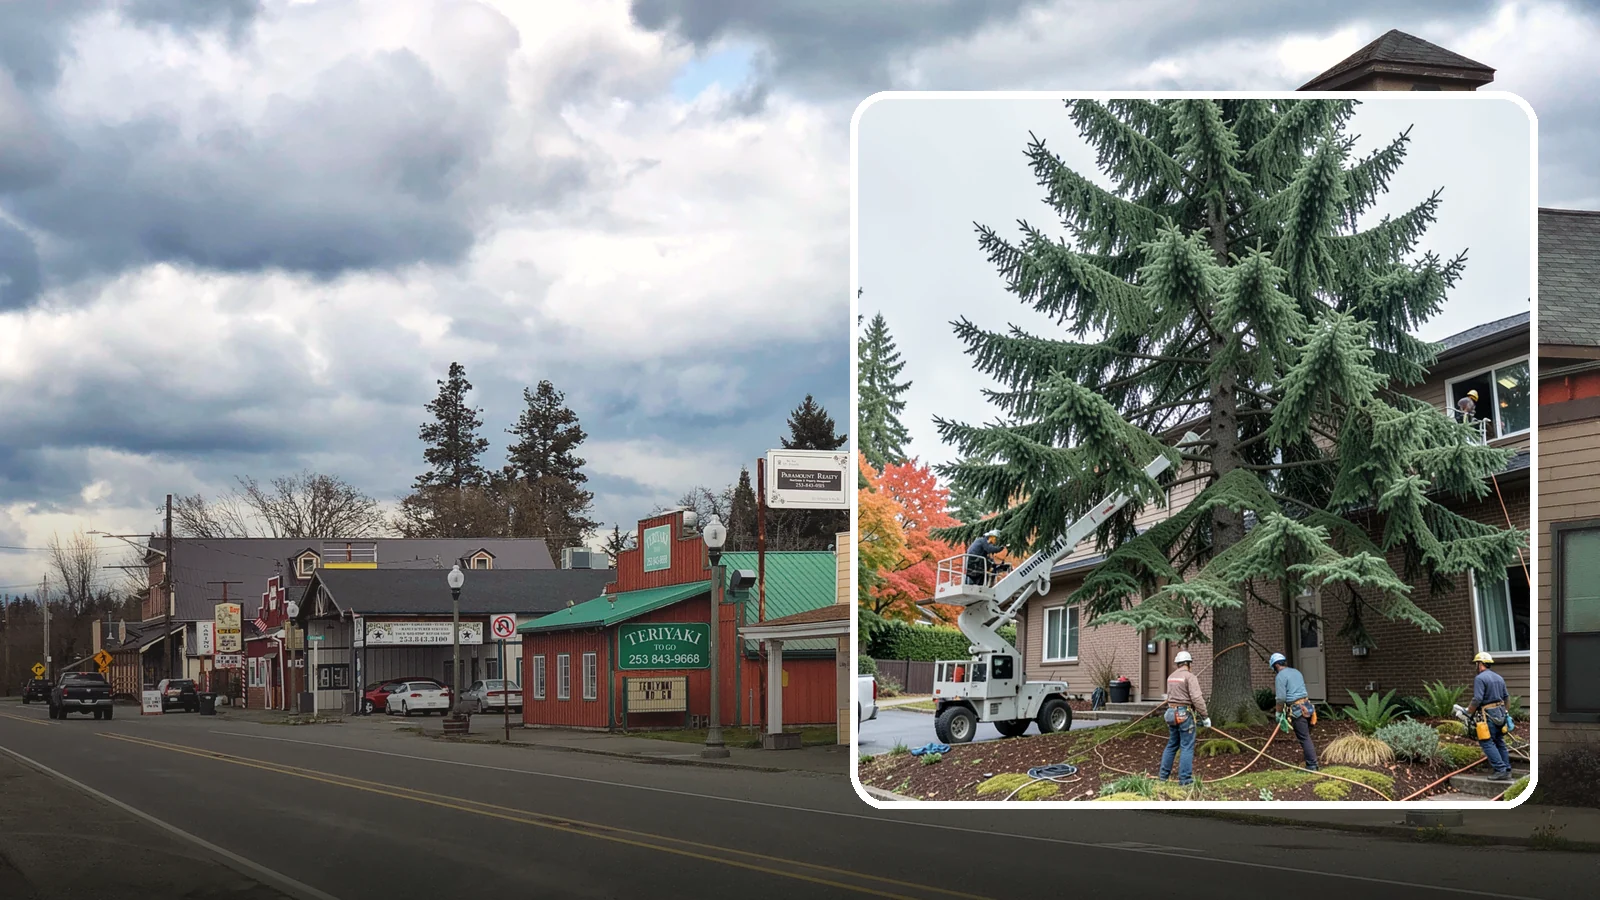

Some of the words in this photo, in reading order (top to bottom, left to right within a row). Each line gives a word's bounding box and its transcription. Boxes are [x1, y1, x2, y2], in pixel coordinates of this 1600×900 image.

[781, 471, 815, 479] PARAMOUNT
[817, 472, 839, 480] REALTY
[625, 628, 702, 646] TERIYAKI
[628, 654, 648, 664] 253
[652, 654, 700, 664] 843-9668
[639, 681, 672, 690] TERIYAKI
